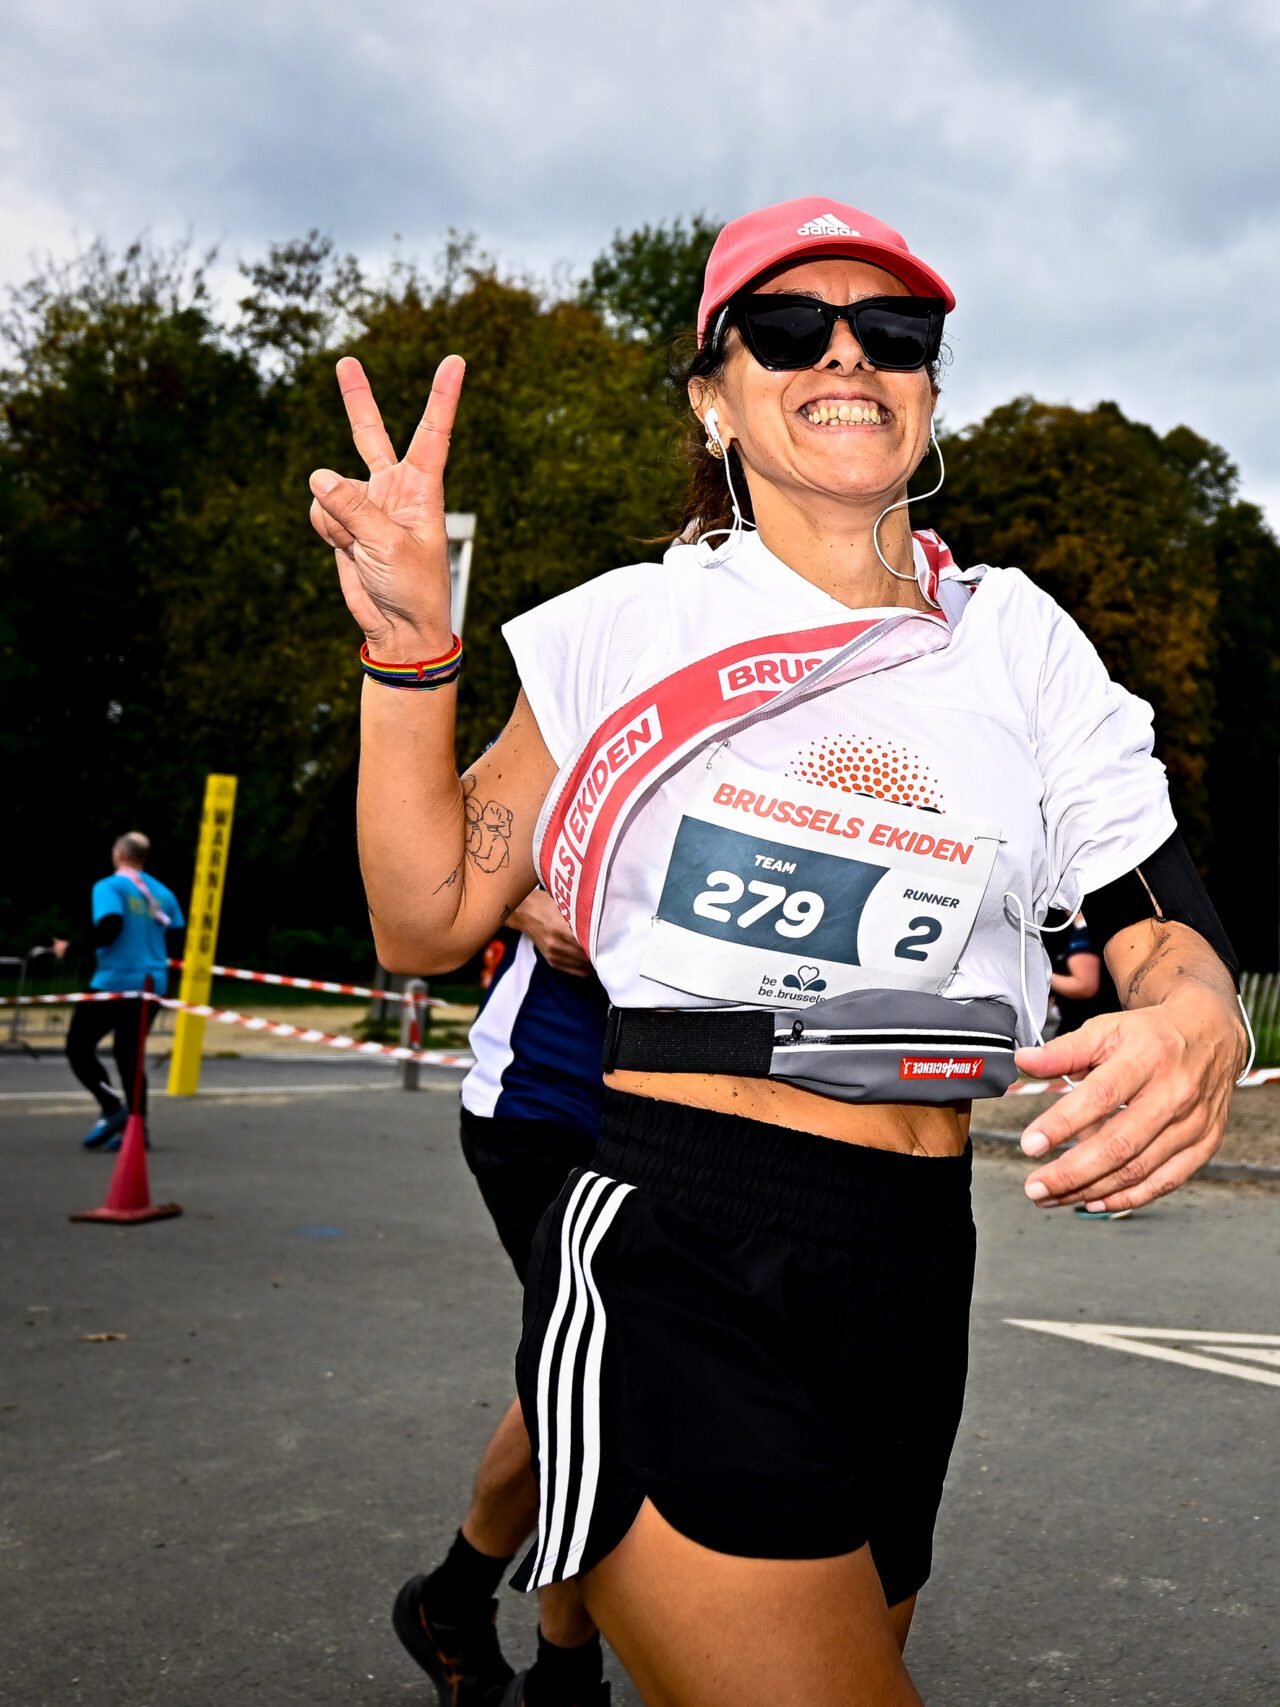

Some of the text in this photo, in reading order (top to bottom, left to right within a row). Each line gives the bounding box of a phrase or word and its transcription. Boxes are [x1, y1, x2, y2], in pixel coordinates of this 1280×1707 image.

[555, 717, 652, 926] SELS EKIDEN
[713, 782, 974, 865] BRUSSELS EKIDEN
[200, 808, 227, 955] WARNING
[755, 854, 797, 875] TEAM
[693, 870, 825, 938] 279
[903, 888, 960, 909] RUNNER
[894, 916, 942, 962] 2
[761, 974, 777, 986] be
